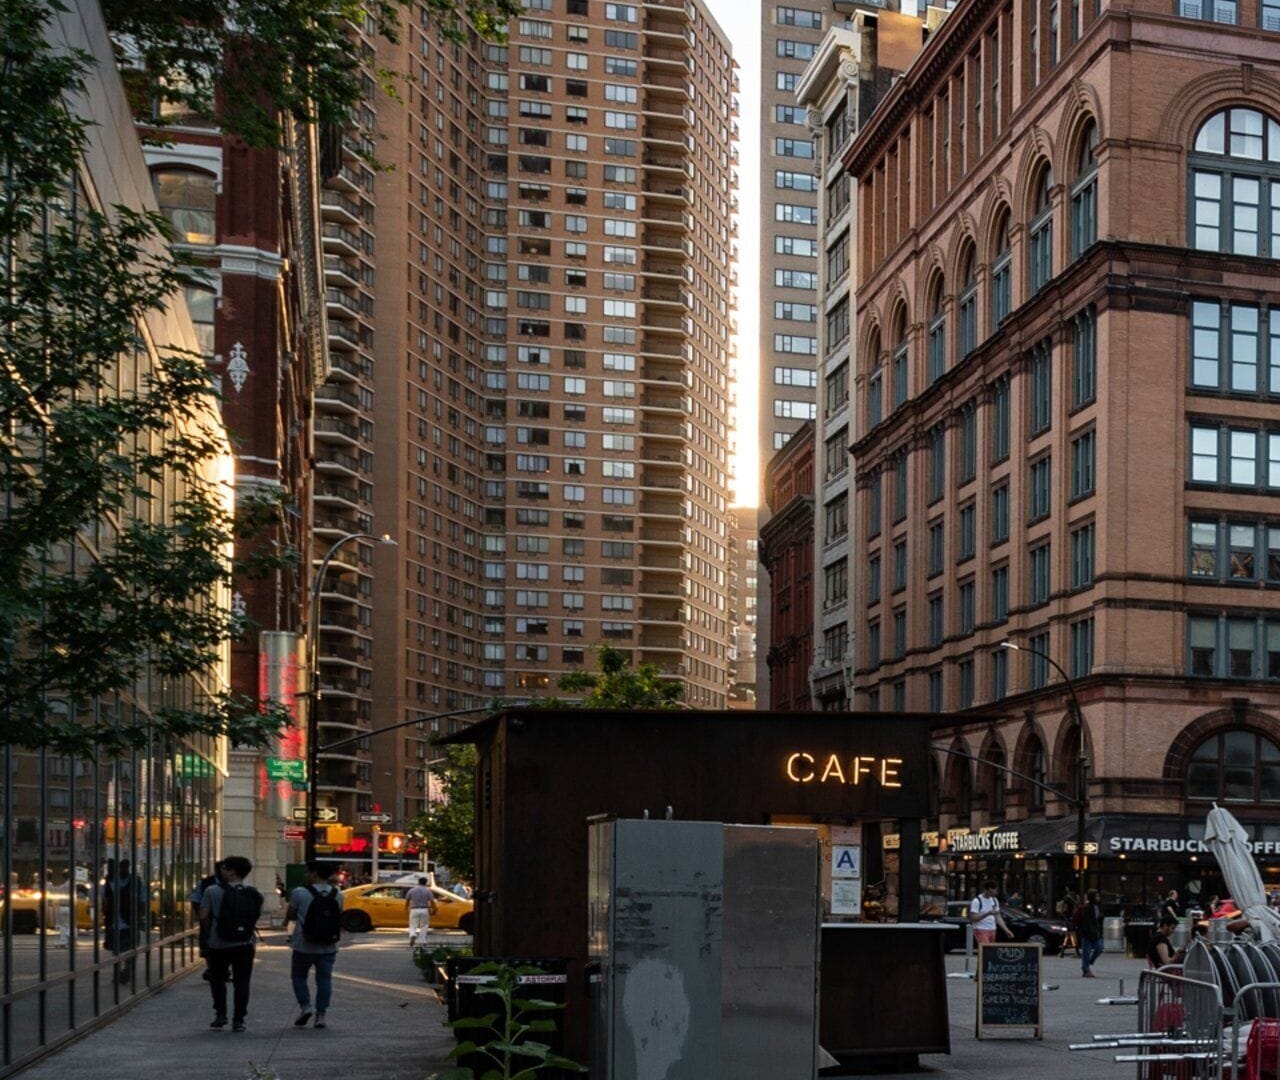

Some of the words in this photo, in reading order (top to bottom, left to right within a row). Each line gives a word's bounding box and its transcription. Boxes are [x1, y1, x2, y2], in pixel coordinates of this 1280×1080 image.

[787, 752, 903, 787] CAFE
[951, 832, 991, 852] STARBUCKS
[992, 831, 1019, 850] COFFEE
[1110, 836, 1210, 854] STARBUCK
[836, 850, 855, 869] A
